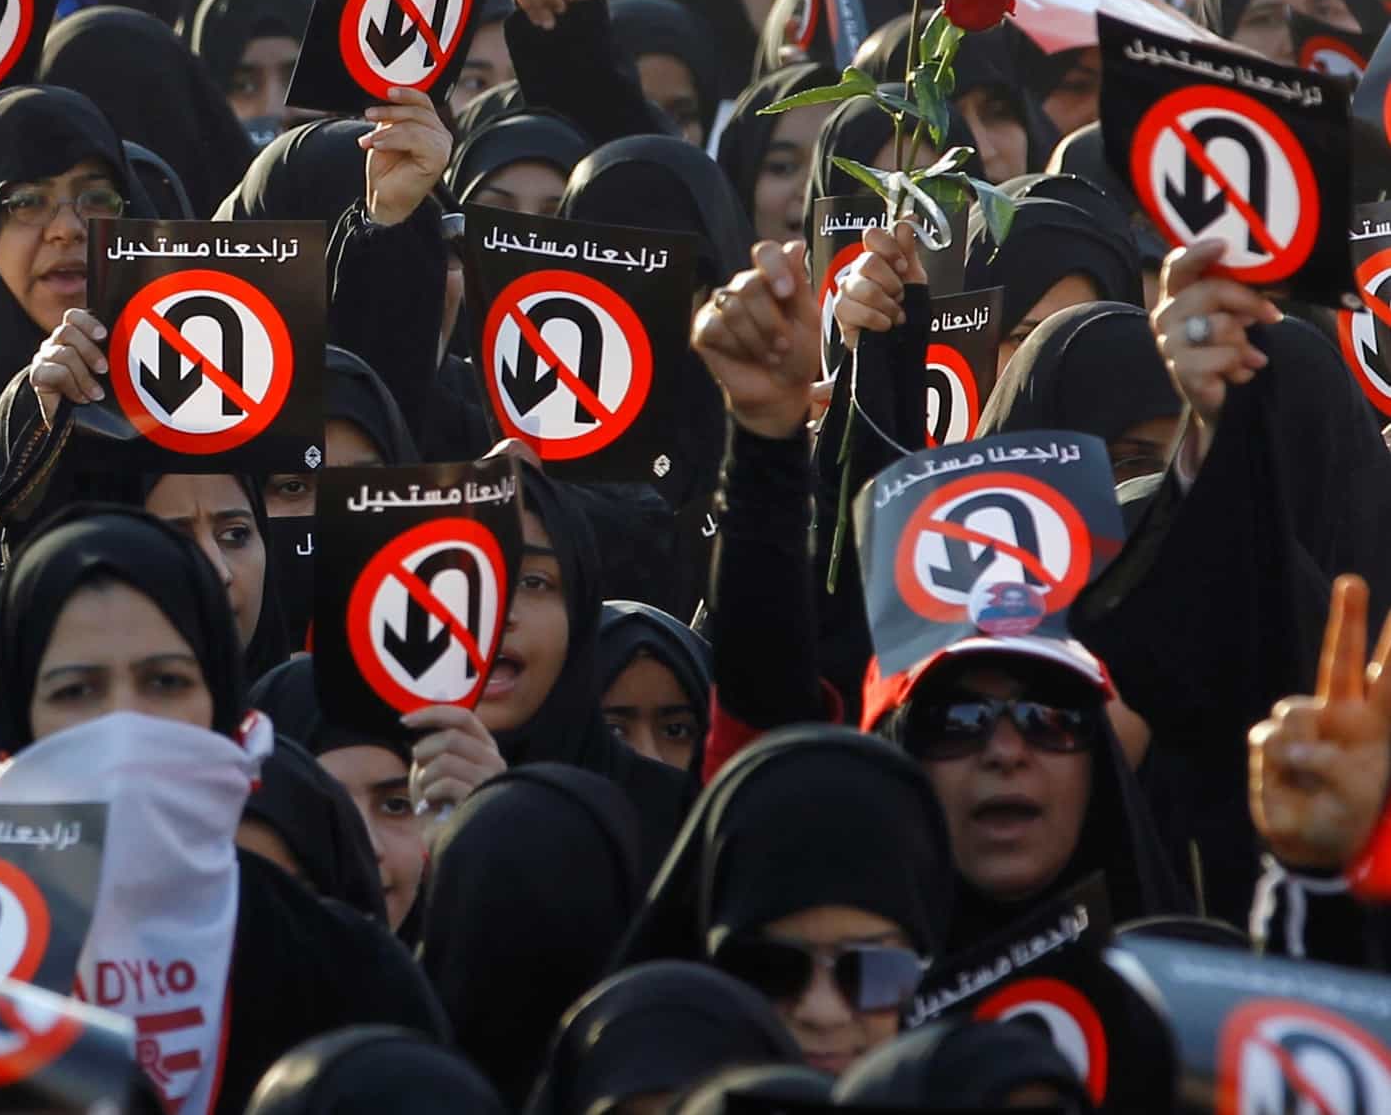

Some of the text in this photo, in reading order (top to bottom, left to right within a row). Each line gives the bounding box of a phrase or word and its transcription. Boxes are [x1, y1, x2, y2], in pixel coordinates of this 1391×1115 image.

[1125, 38, 1323, 107] تراجعنا مستحيل
[106, 236, 299, 263] تراجعنا مستحيل
[483, 226, 668, 273] تراجعنا مستحيل
[941, 306, 989, 333] تراجعنا
[346, 474, 516, 513] تراجعنا مستحيل
[873, 442, 1081, 509] تراجعنا مستحيل
